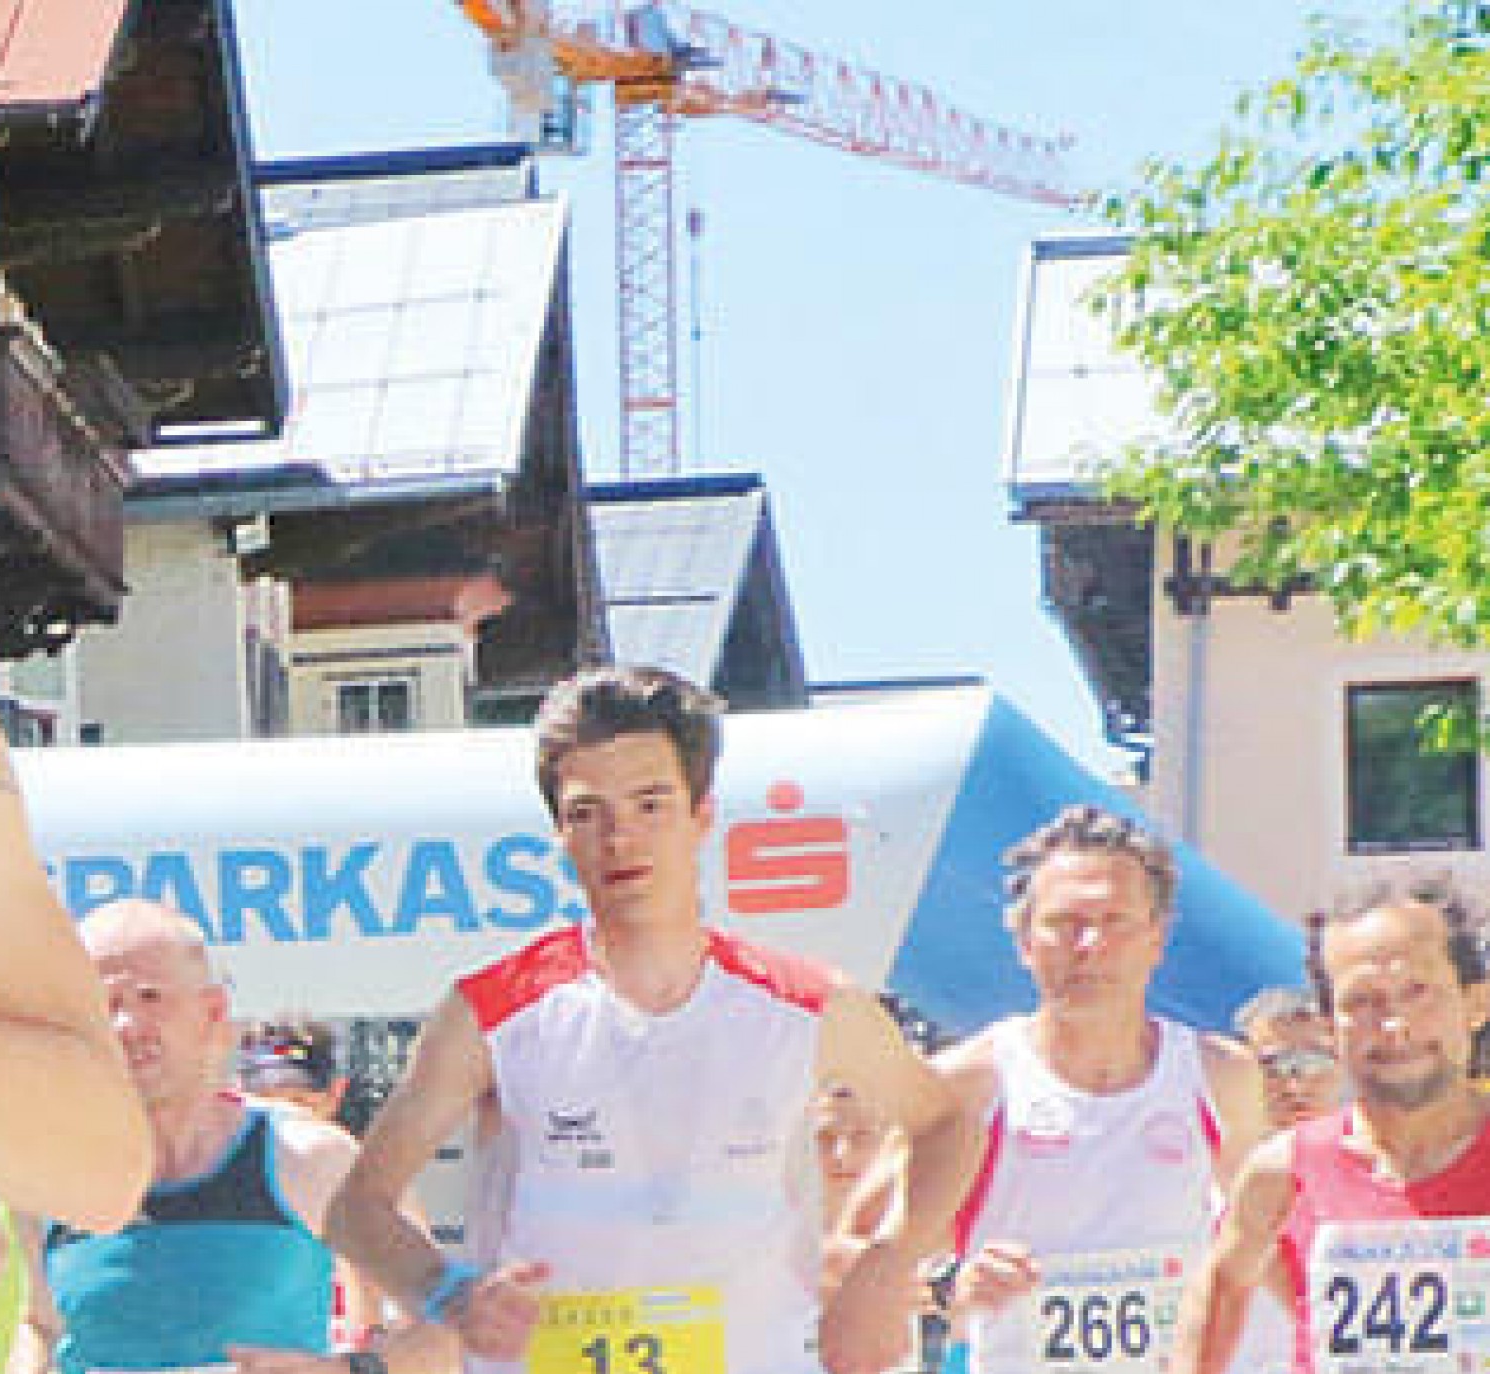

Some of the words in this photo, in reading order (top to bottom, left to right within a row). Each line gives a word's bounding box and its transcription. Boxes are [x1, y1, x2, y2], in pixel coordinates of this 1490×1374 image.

[46, 834, 592, 944] PARKAS
[1040, 1290, 1151, 1360] 266
[1327, 1271, 1449, 1355] 242
